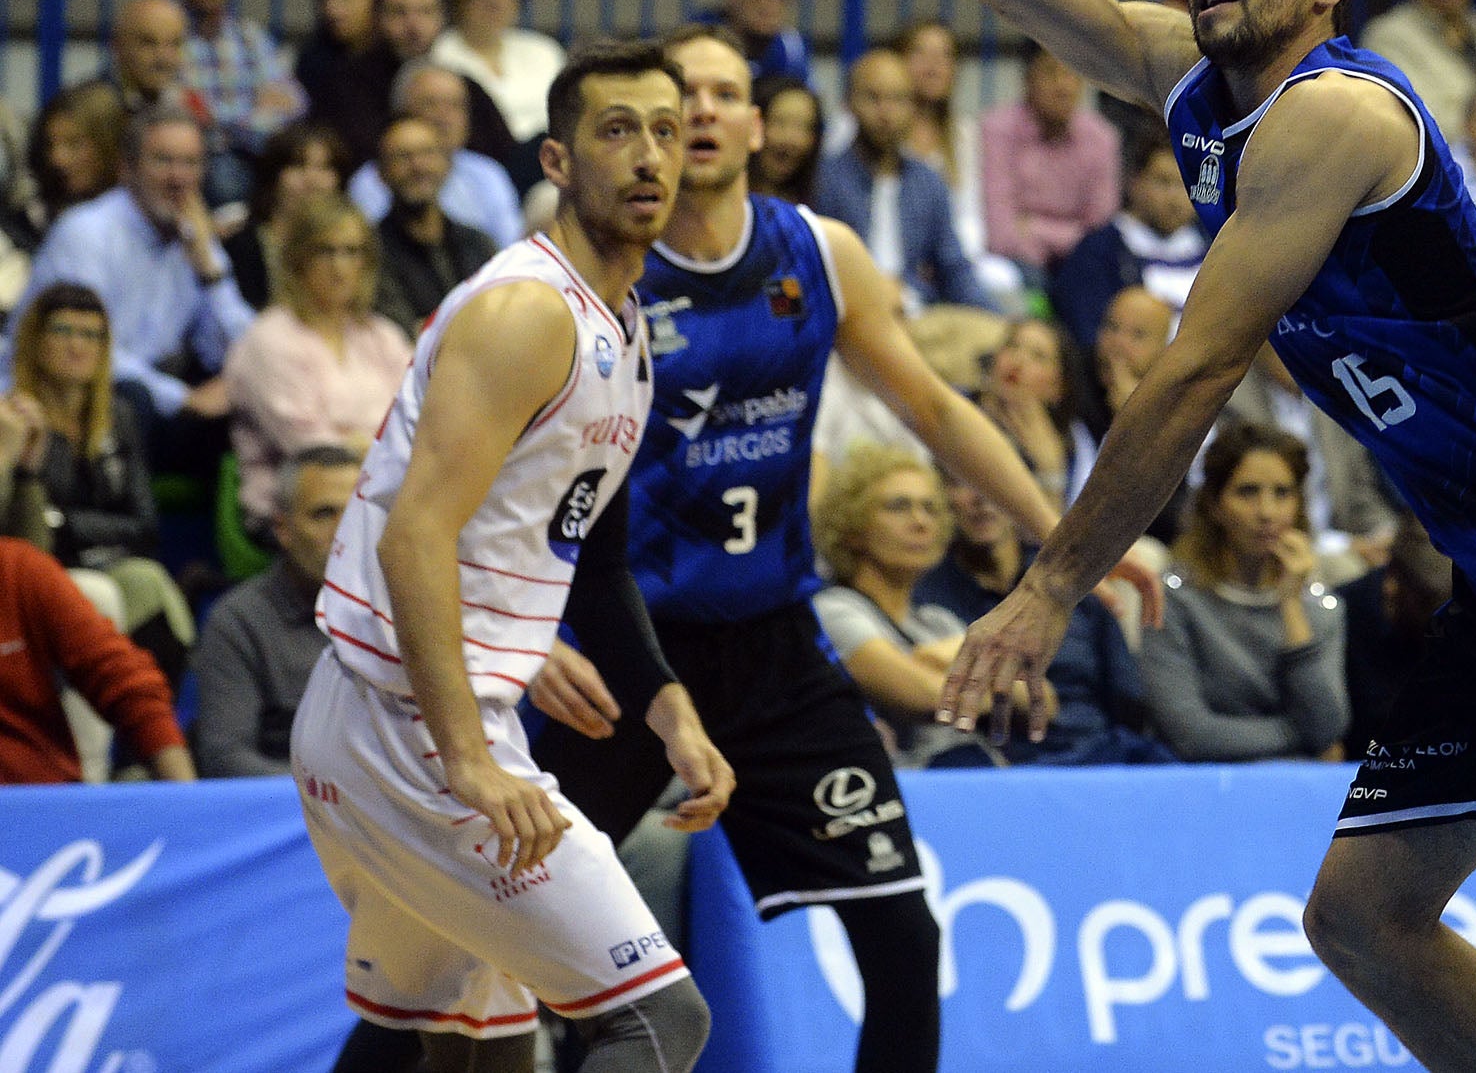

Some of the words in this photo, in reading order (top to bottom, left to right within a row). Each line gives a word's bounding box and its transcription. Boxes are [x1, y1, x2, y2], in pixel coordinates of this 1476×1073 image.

[1331, 352, 1418, 432] 15
[685, 427, 792, 469] BURGOS
[721, 485, 758, 555] 3
